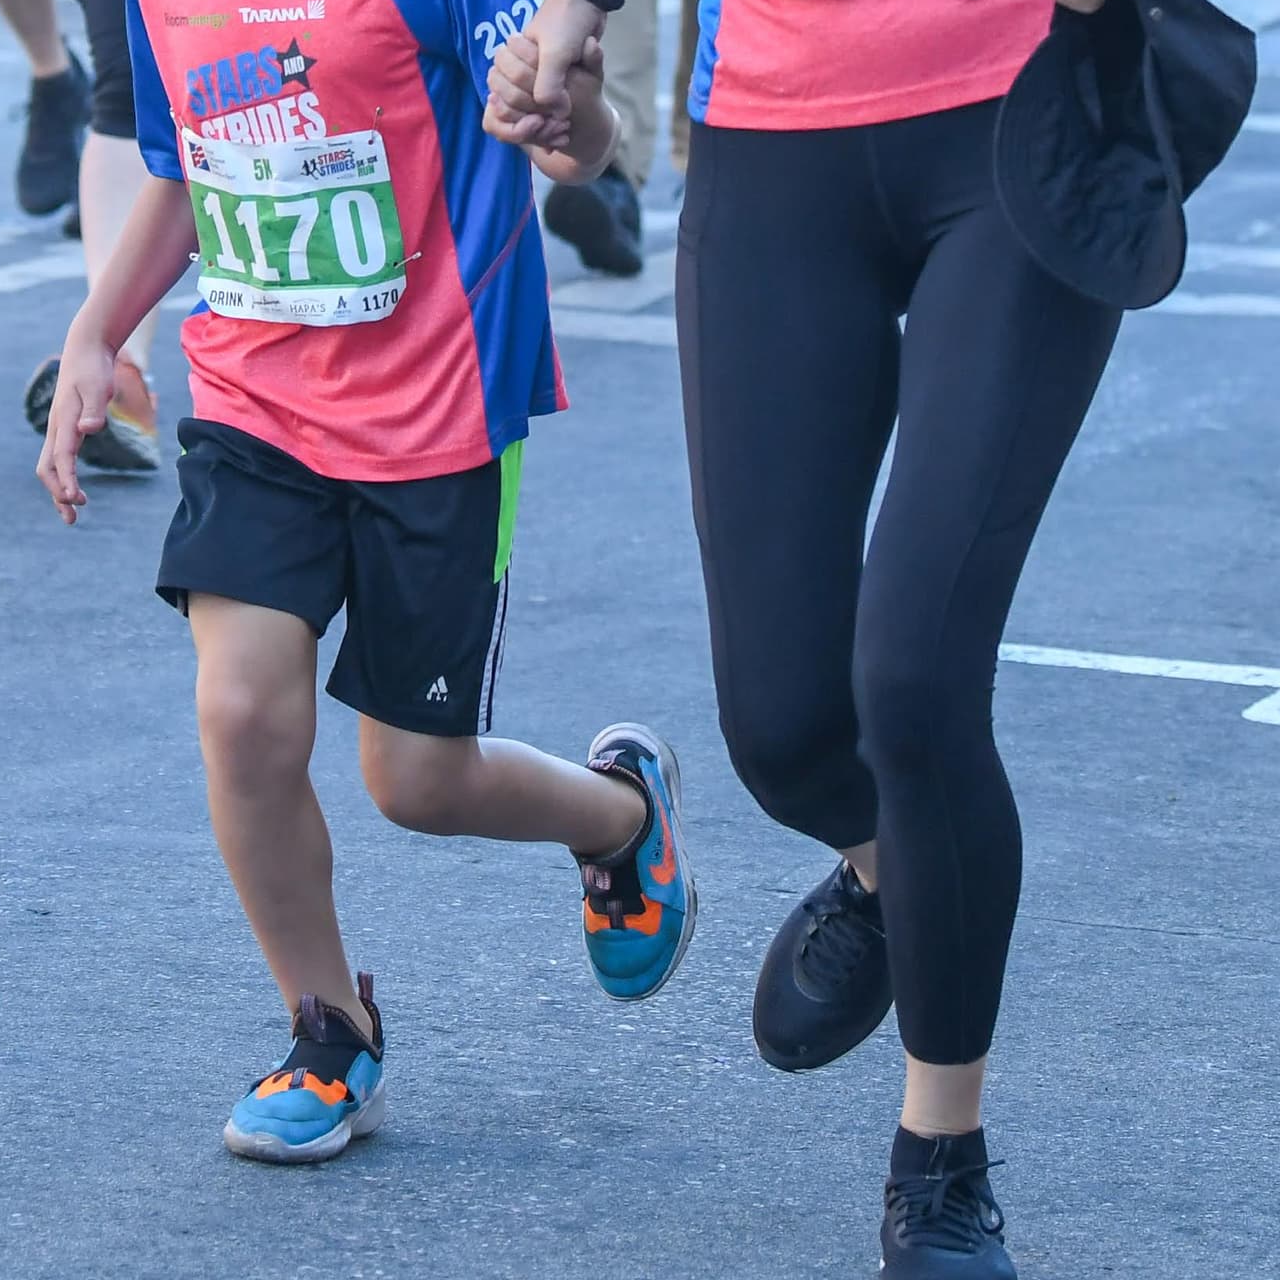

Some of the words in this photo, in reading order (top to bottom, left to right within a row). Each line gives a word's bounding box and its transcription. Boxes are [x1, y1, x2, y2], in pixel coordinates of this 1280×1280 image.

[238, 7, 306, 24] TARANA
[283, 55, 305, 76] AND
[186, 44, 283, 116] STARS
[317, 150, 346, 166] STARS
[319, 157, 356, 176] STRIDES
[253, 158, 273, 180] 5K
[203, 190, 387, 282] 1170
[209, 290, 244, 308] DRINK
[289, 304, 326, 313] HAPA'S
[362, 288, 399, 312] 1170
